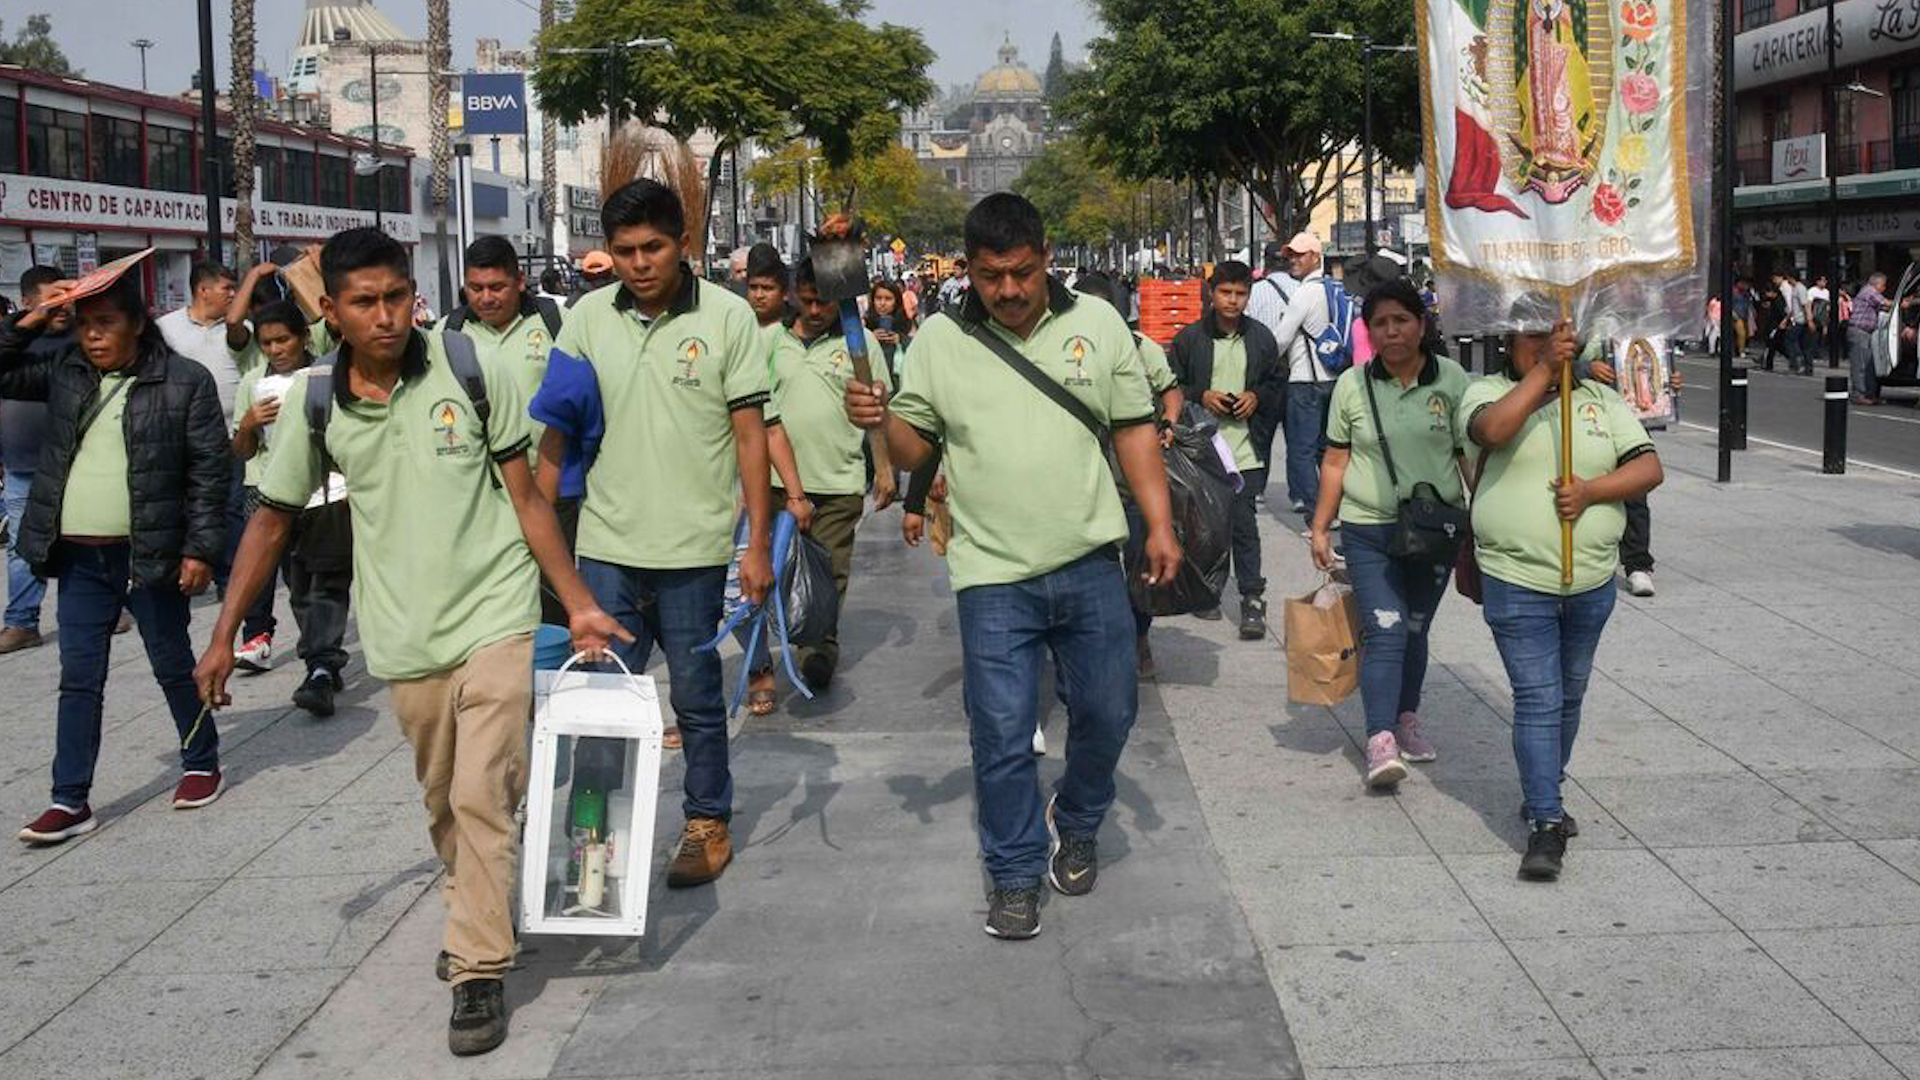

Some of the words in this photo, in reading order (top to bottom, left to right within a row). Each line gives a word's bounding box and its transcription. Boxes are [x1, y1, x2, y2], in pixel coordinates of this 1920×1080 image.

[467, 94, 518, 111] BBVA
[28, 188, 92, 213] CENTRO
[100, 197, 118, 215] DE
[124, 200, 208, 222] CAPACITACI
[261, 210, 273, 226] EL
[277, 211, 323, 230] TRABAJO
